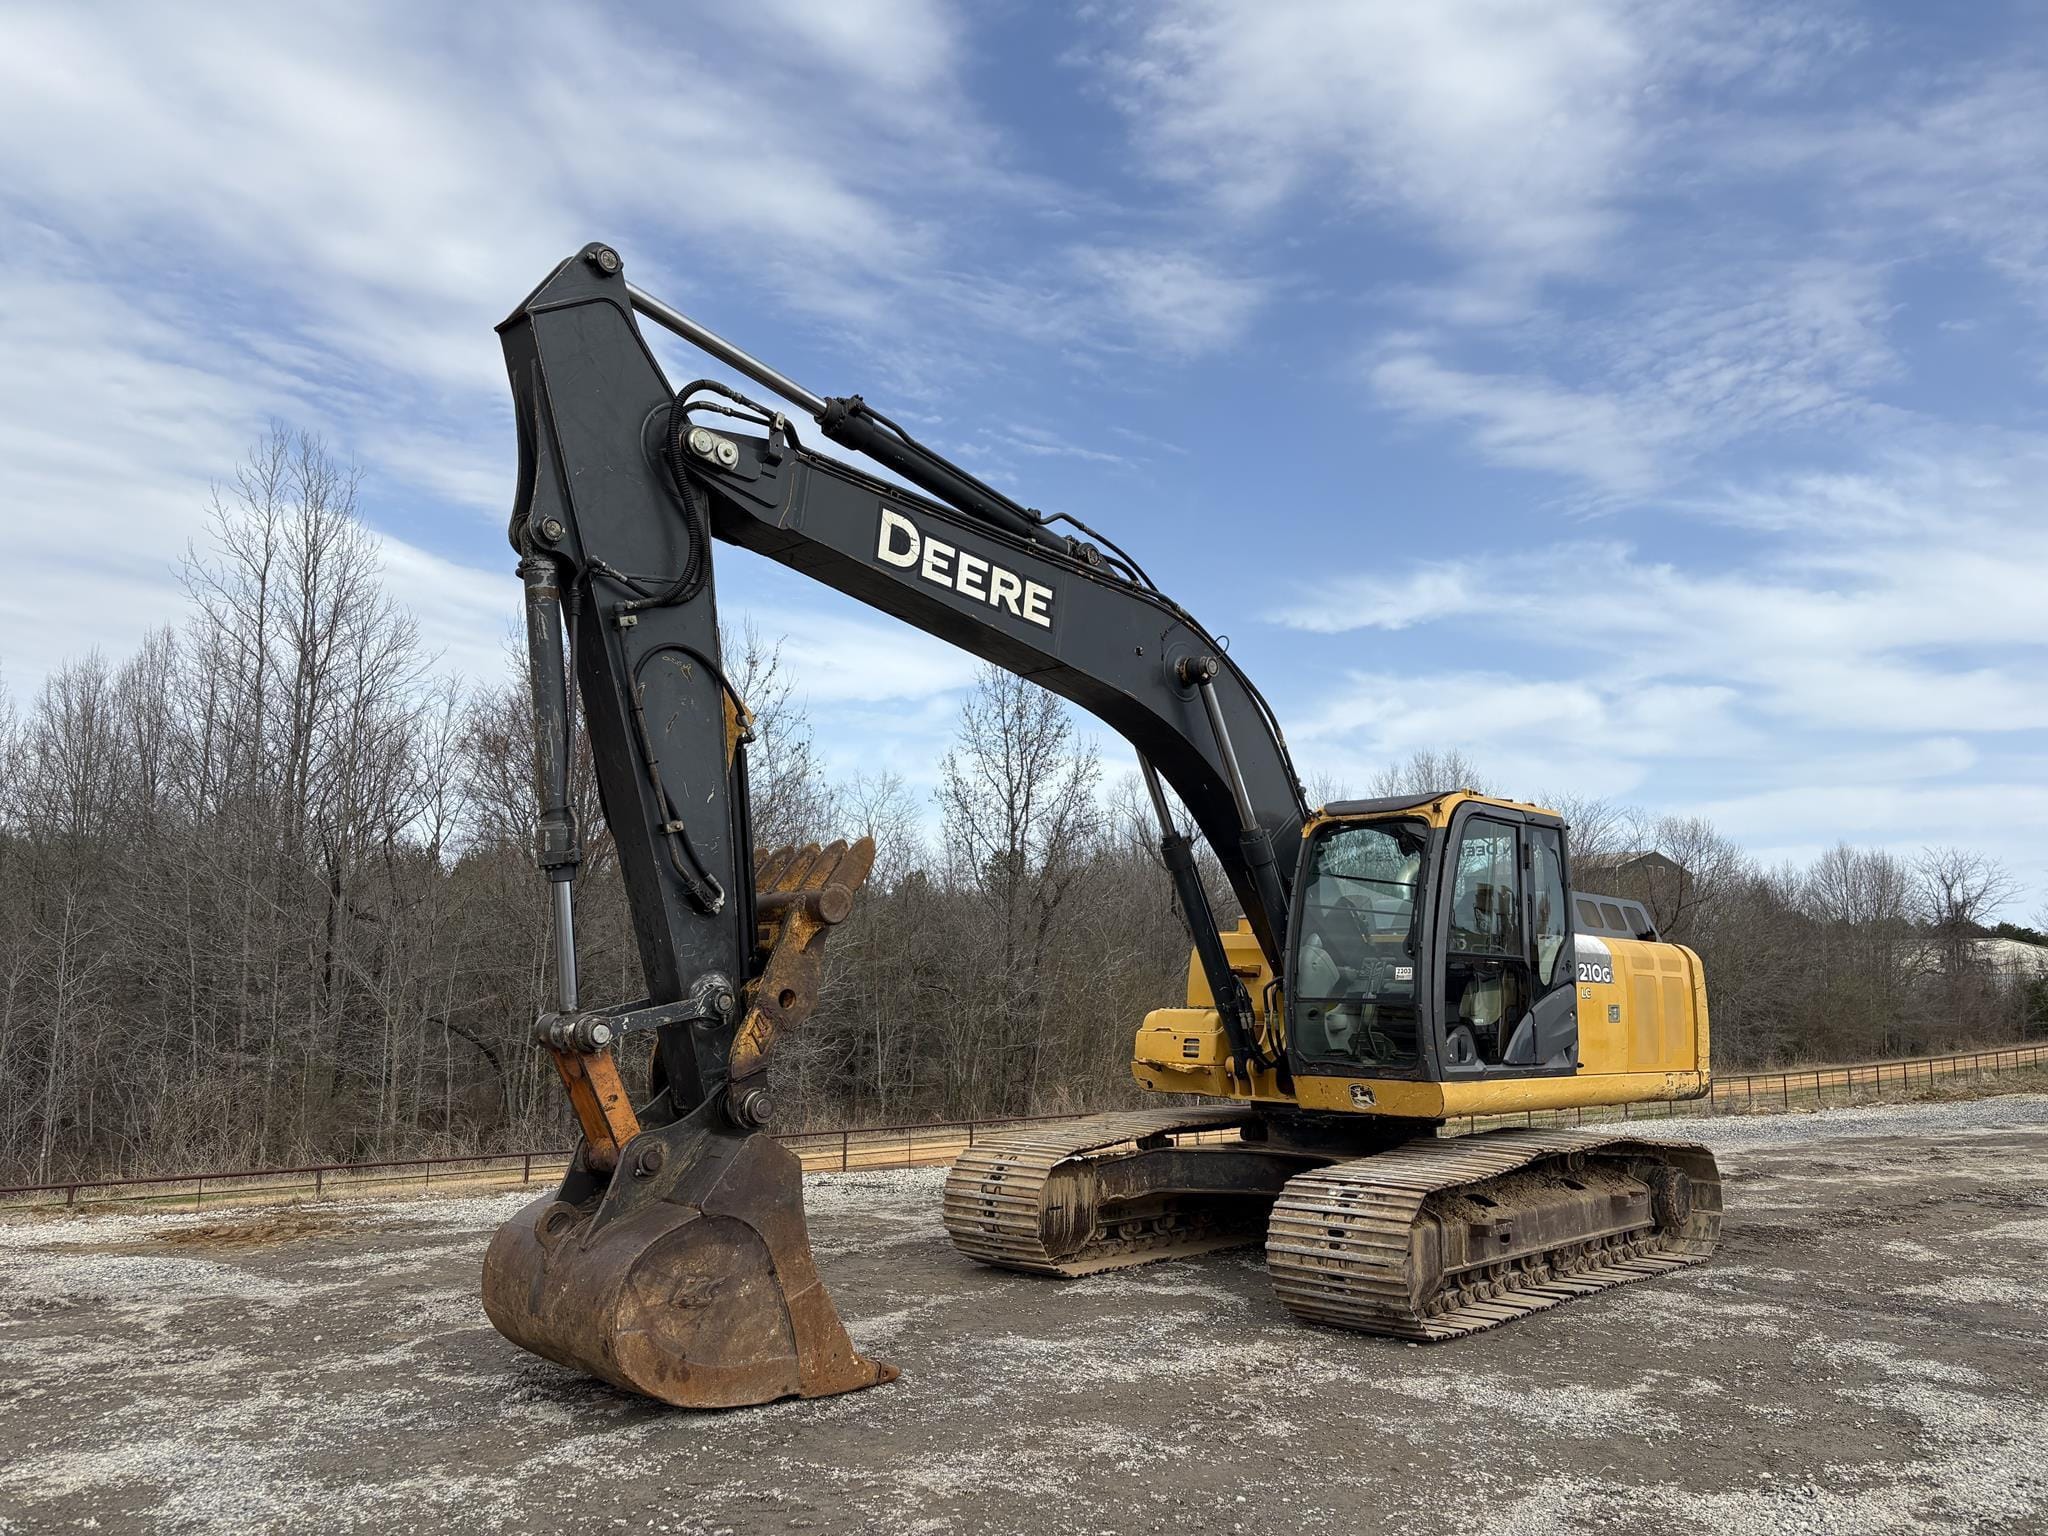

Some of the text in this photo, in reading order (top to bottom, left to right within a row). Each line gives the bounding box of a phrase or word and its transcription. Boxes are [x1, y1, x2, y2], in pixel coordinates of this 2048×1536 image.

[878, 508, 1052, 628] DEERE
[1578, 963, 1611, 983] 210G
[1581, 987, 1591, 999] LC
